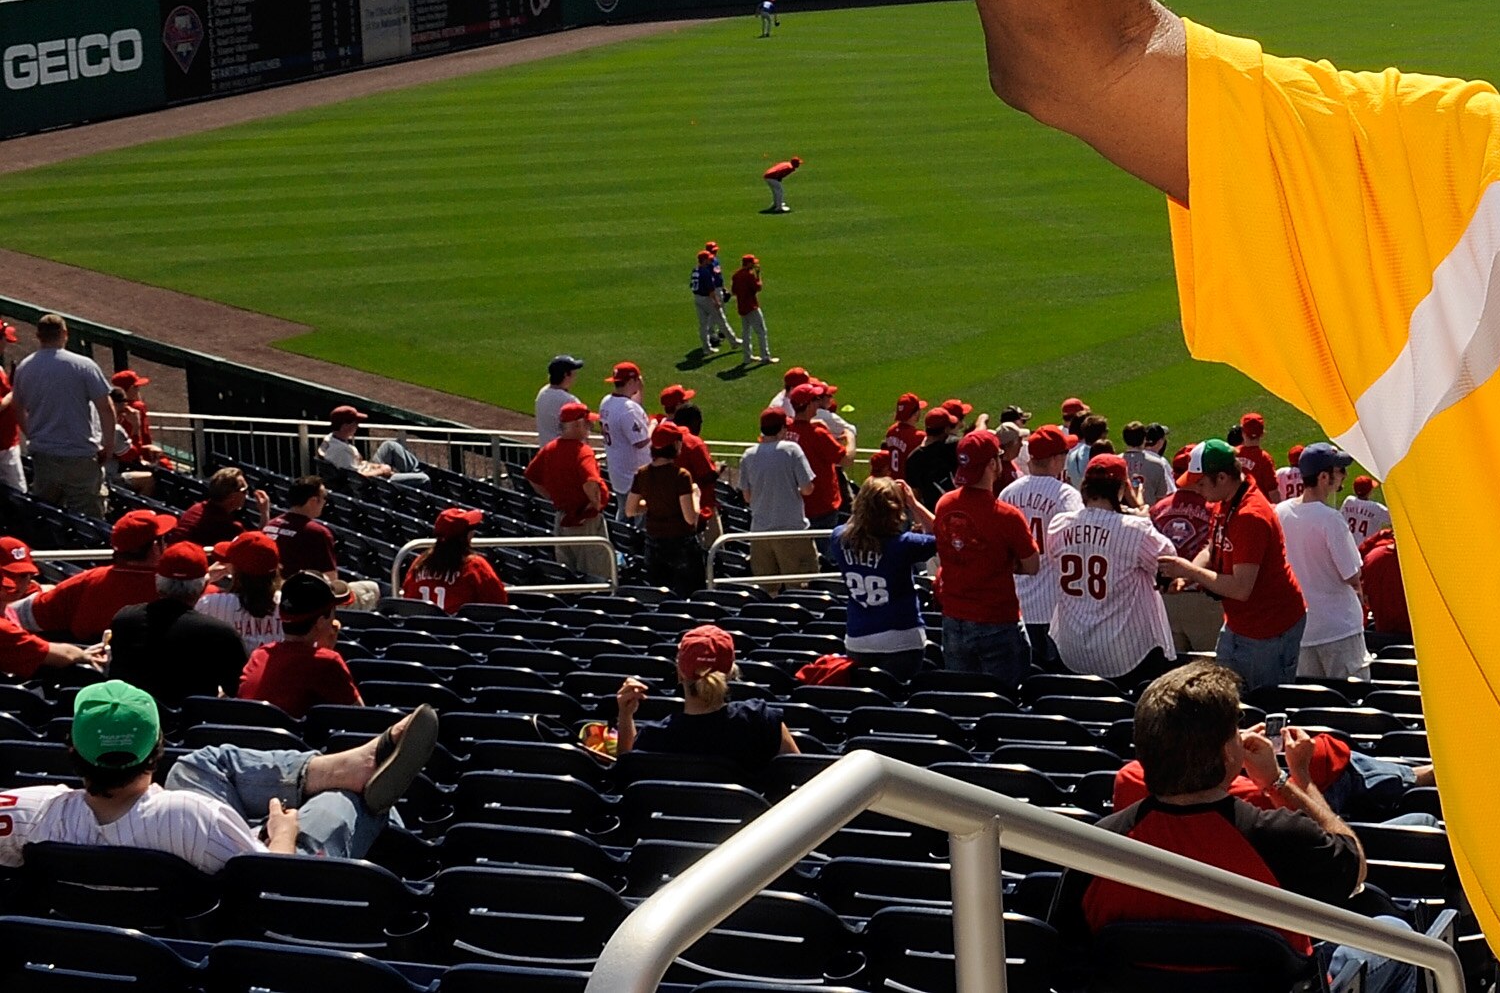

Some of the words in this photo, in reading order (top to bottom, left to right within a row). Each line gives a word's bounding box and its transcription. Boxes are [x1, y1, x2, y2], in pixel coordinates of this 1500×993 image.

[3, 28, 143, 90] GEICO
[1063, 525, 1111, 548] WERTH
[845, 572, 890, 608] 26
[1060, 554, 1108, 601] 28
